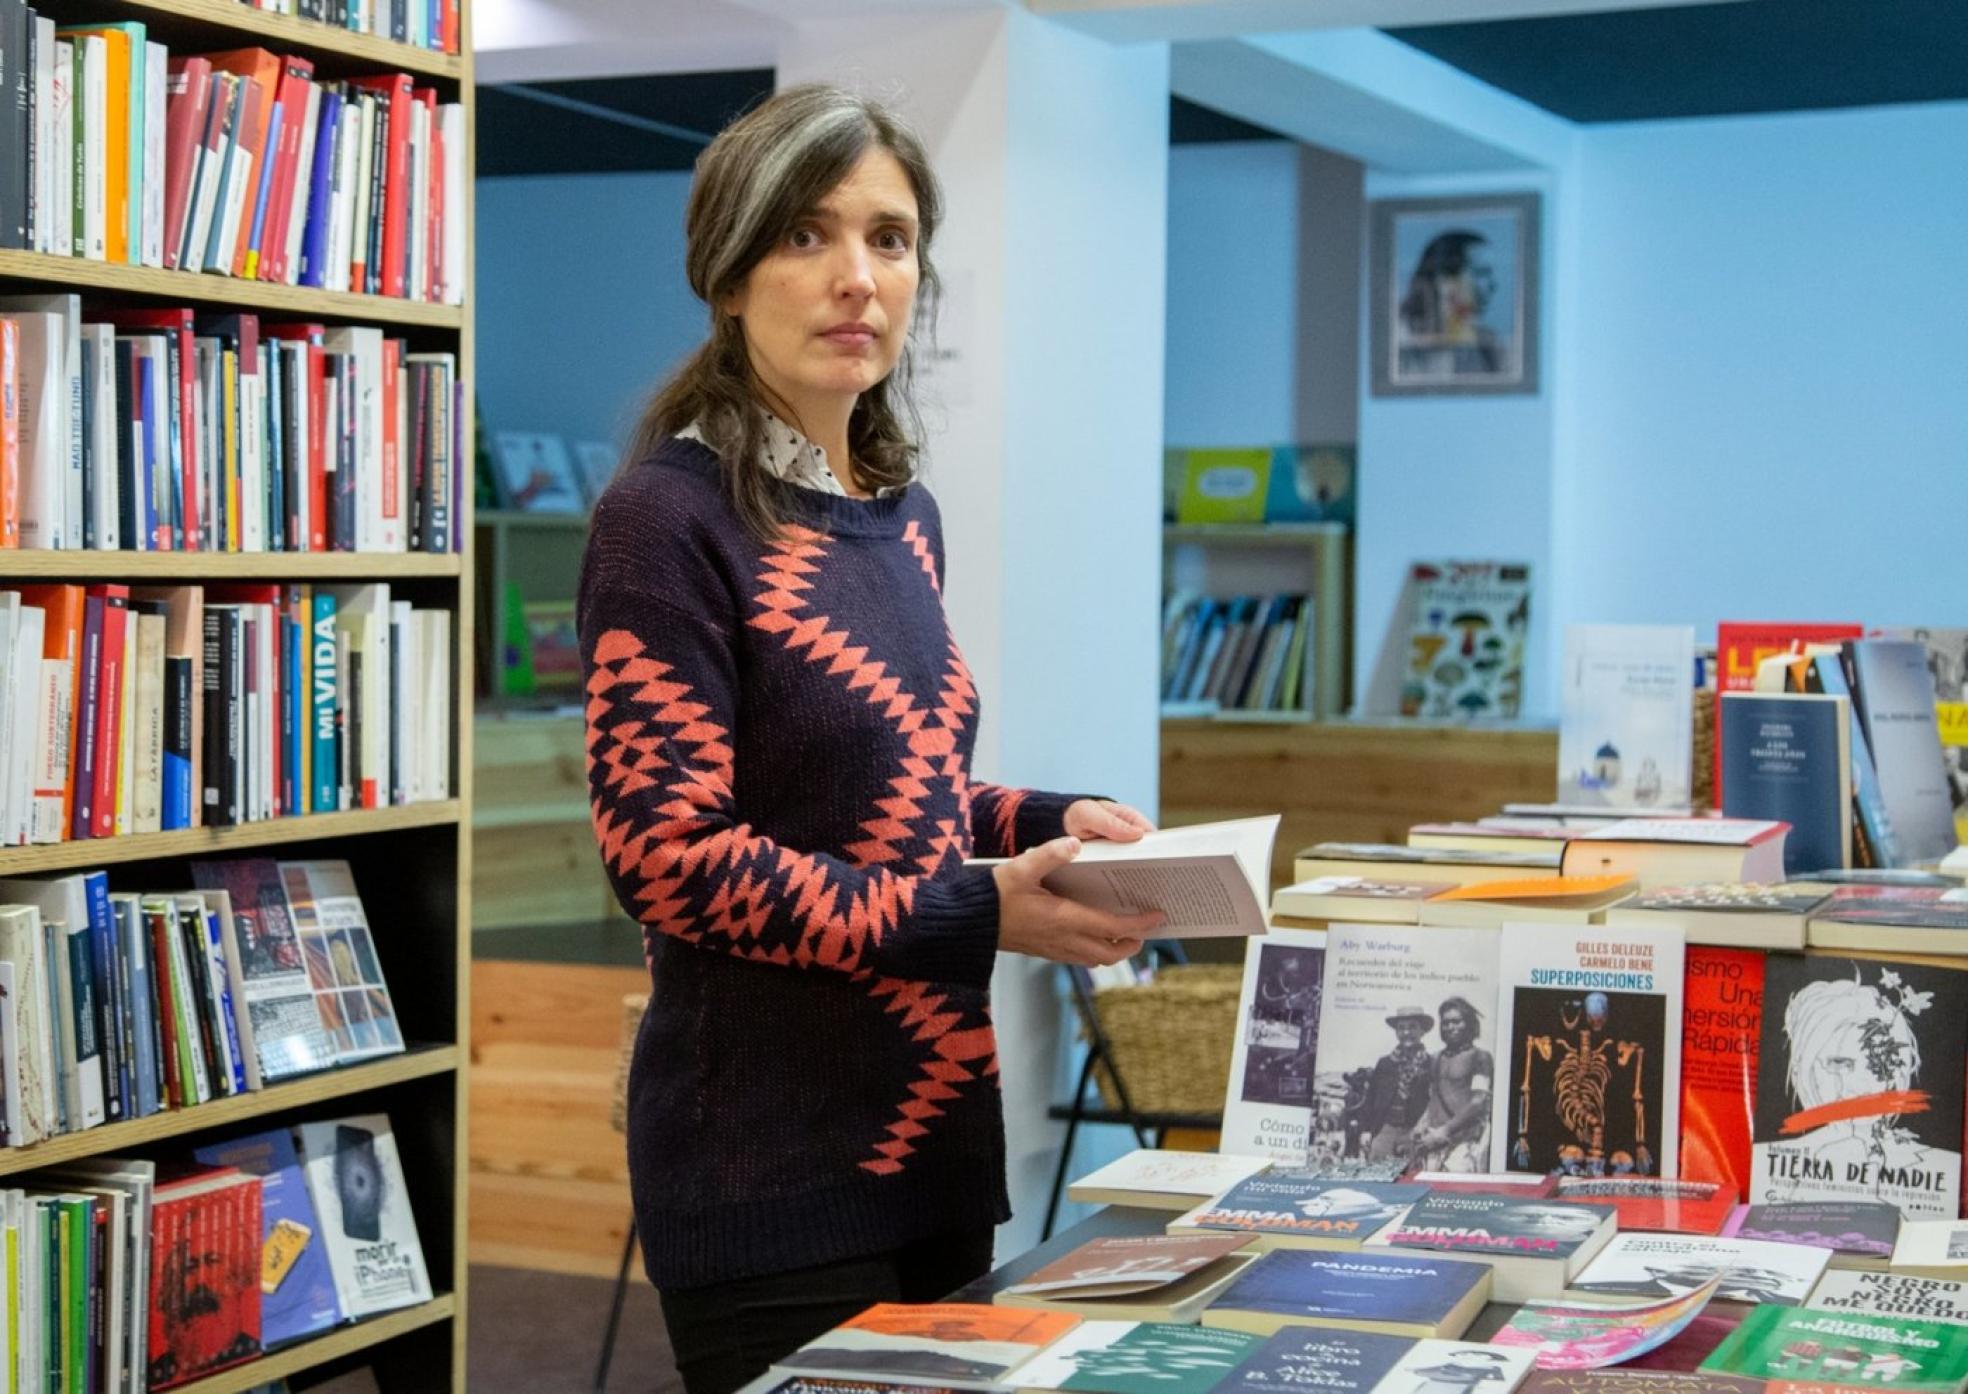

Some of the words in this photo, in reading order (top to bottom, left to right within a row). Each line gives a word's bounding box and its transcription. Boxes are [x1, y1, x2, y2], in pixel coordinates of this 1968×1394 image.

[315, 613, 337, 704] VIDA
[319, 708, 334, 739] MI
[1340, 940, 1361, 952] Aby
[1366, 941, 1411, 953] Warburg
[1576, 942, 1609, 954] GILLES
[1612, 944, 1654, 957] DELEUZE
[1580, 957, 1626, 969] CARMELO
[1629, 959, 1654, 970] BENE
[1531, 969, 1654, 990] SUPERPOSICIONES
[1260, 1117, 1305, 1135] Cómo
[1254, 1136, 1264, 1146] a
[1268, 1136, 1288, 1149] un
[1768, 1154, 1834, 1182] TIERRA
[1847, 1162, 1872, 1184] DE
[1879, 1167, 1948, 1192] NADIE
[354, 1241, 398, 1262] morir
[1311, 1261, 1438, 1277] PANDEMIA
[1860, 1274, 1962, 1292] NEGRO
[1823, 1296, 1865, 1308] ME
[1851, 1290, 1955, 1309] NEGRO
[1303, 1342, 1360, 1355] libro
[1280, 1353, 1361, 1366] cocina
[1275, 1365, 1341, 1377] Alice
[1280, 1373, 1358, 1388] Toklas
